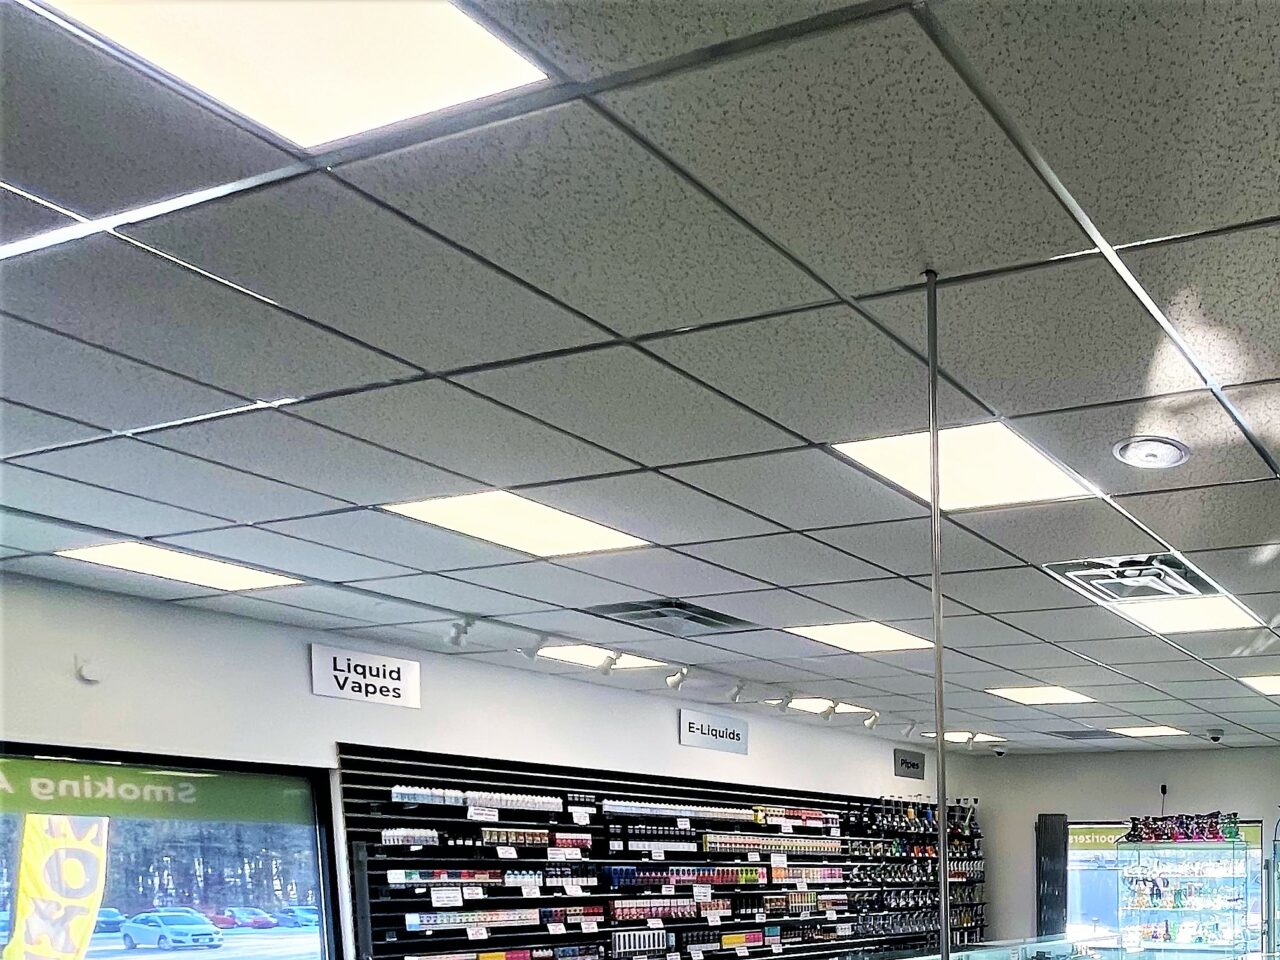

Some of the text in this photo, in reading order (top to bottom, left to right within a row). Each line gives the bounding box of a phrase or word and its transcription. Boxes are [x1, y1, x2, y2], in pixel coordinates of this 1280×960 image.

[332, 656, 402, 681] Liquid
[333, 674, 402, 698] Vapes
[688, 721, 741, 741] E-Liquids
[900, 758, 920, 770] Pipes
